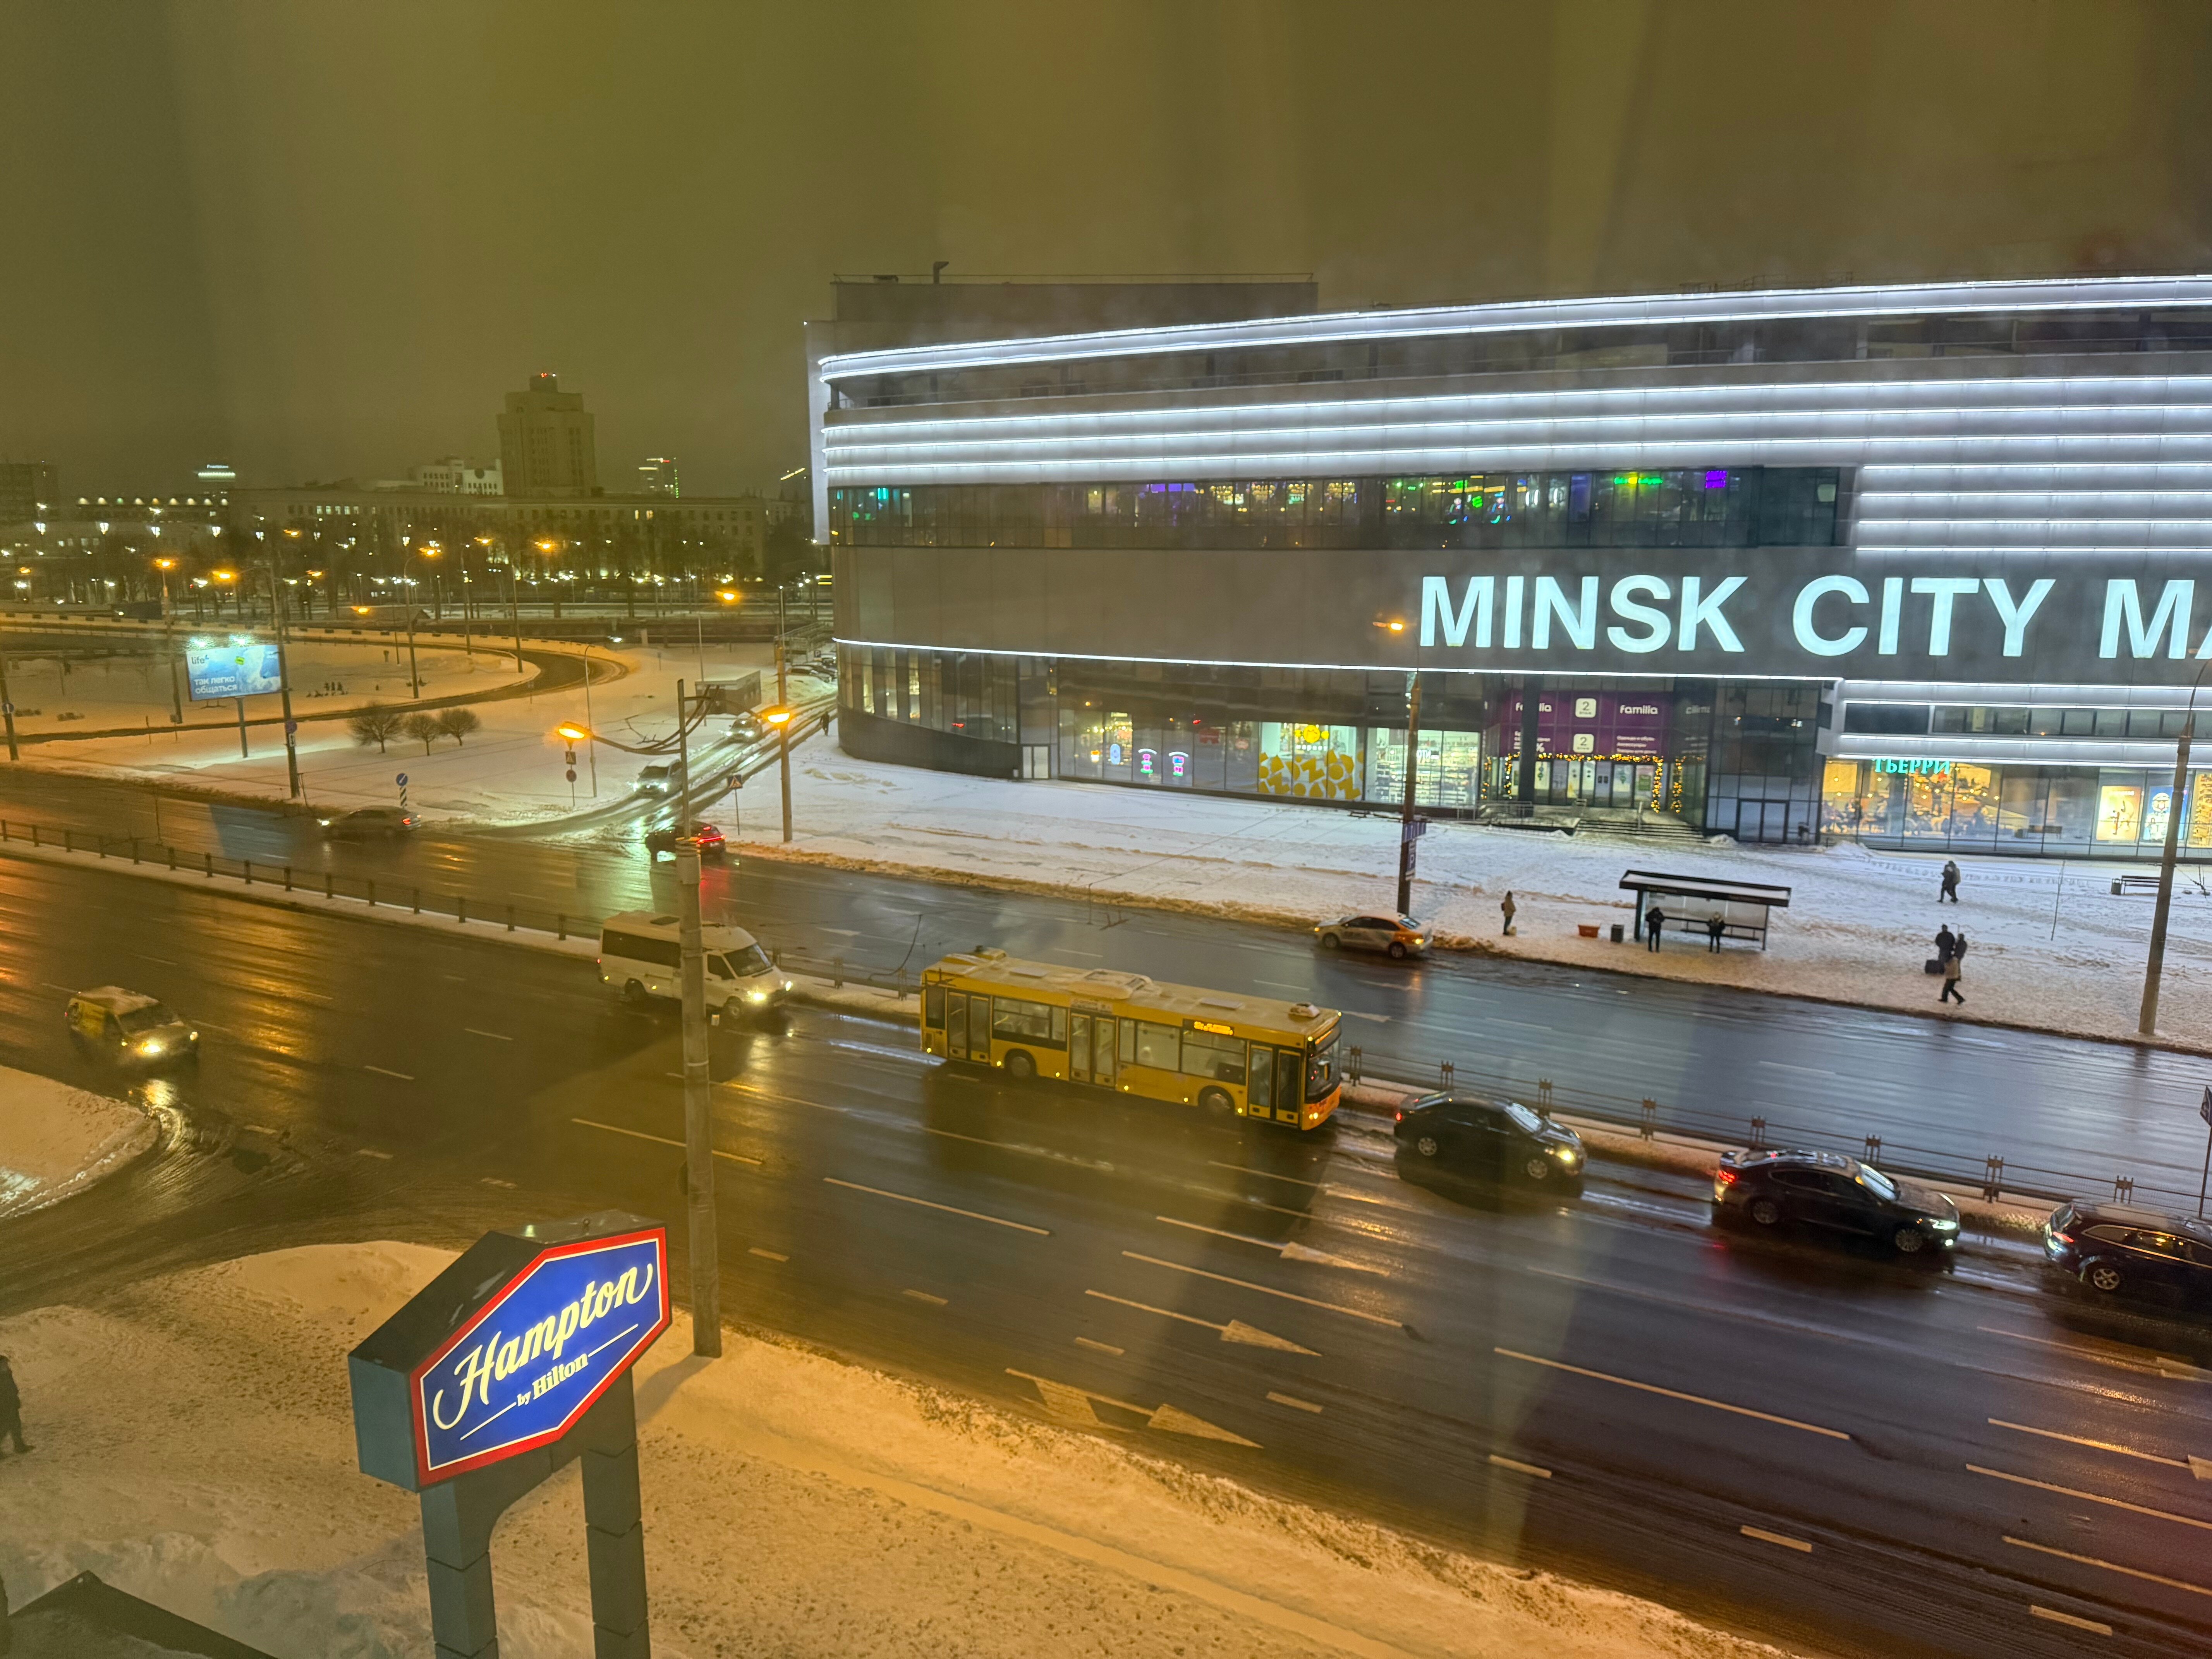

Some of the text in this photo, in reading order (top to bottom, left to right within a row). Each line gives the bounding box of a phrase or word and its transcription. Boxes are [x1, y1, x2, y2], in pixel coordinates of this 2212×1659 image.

[1420, 575, 2212, 659] MINSK CITY M
[211, 676, 235, 685] легко
[196, 685, 237, 694] общаться
[1583, 701, 1589, 711] 2
[1620, 704, 1659, 715] familia
[1580, 737, 1587, 746] 2
[1871, 758, 1950, 775] ТЬЕРРИ
[433, 1263, 653, 1430] Hampton
[517, 1353, 589, 1407] by Hilton
